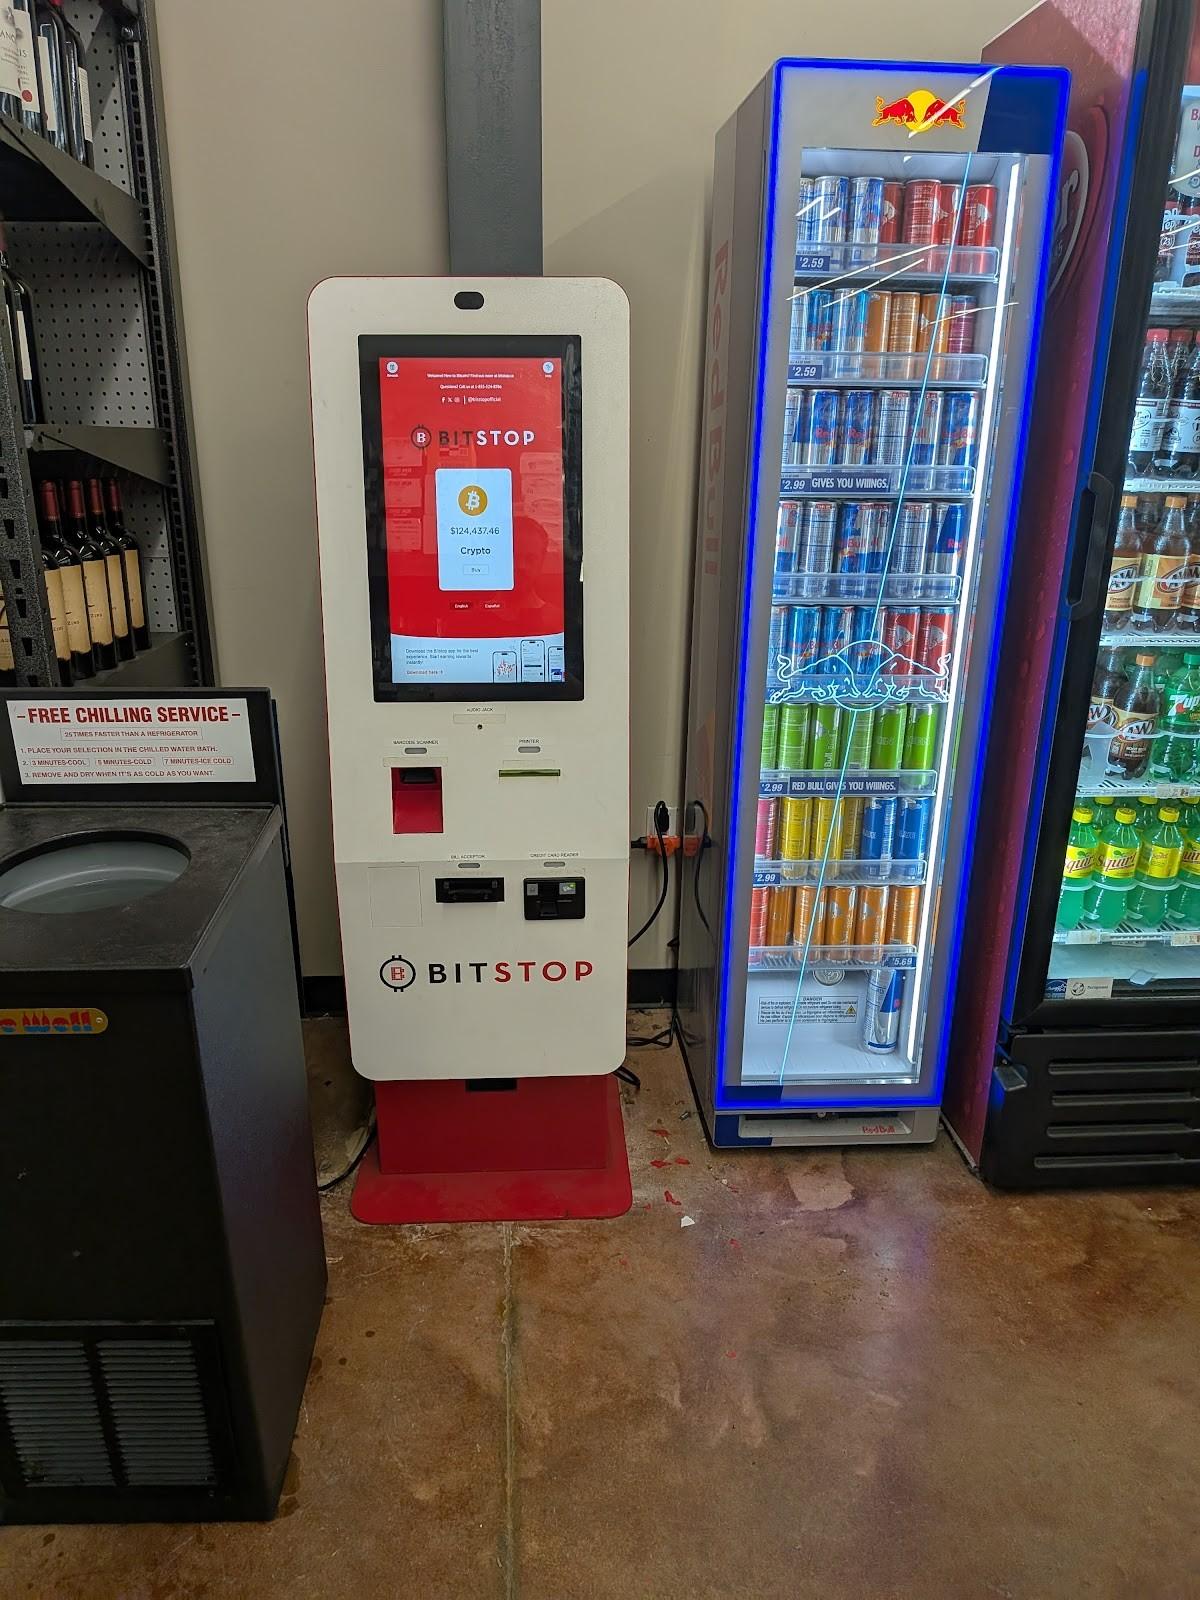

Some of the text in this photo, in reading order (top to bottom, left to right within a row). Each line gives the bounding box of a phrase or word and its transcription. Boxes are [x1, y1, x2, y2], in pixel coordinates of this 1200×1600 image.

[704, 239, 729, 576] Red Bull
[438, 430, 535, 446] BITSTOP
[811, 478, 834, 488] GIVES
[836, 478, 853, 488] YOU
[450, 526, 500, 536] $124,437.46
[460, 546, 491, 556] Crypto
[28, 706, 229, 724] FREE CHILLING SERVICE
[791, 782, 806, 791] RED
[807, 782, 824, 791] BULL
[826, 782, 846, 790] GIVS
[848, 782, 863, 791] YOU
[428, 960, 594, 984] BITSTOP
